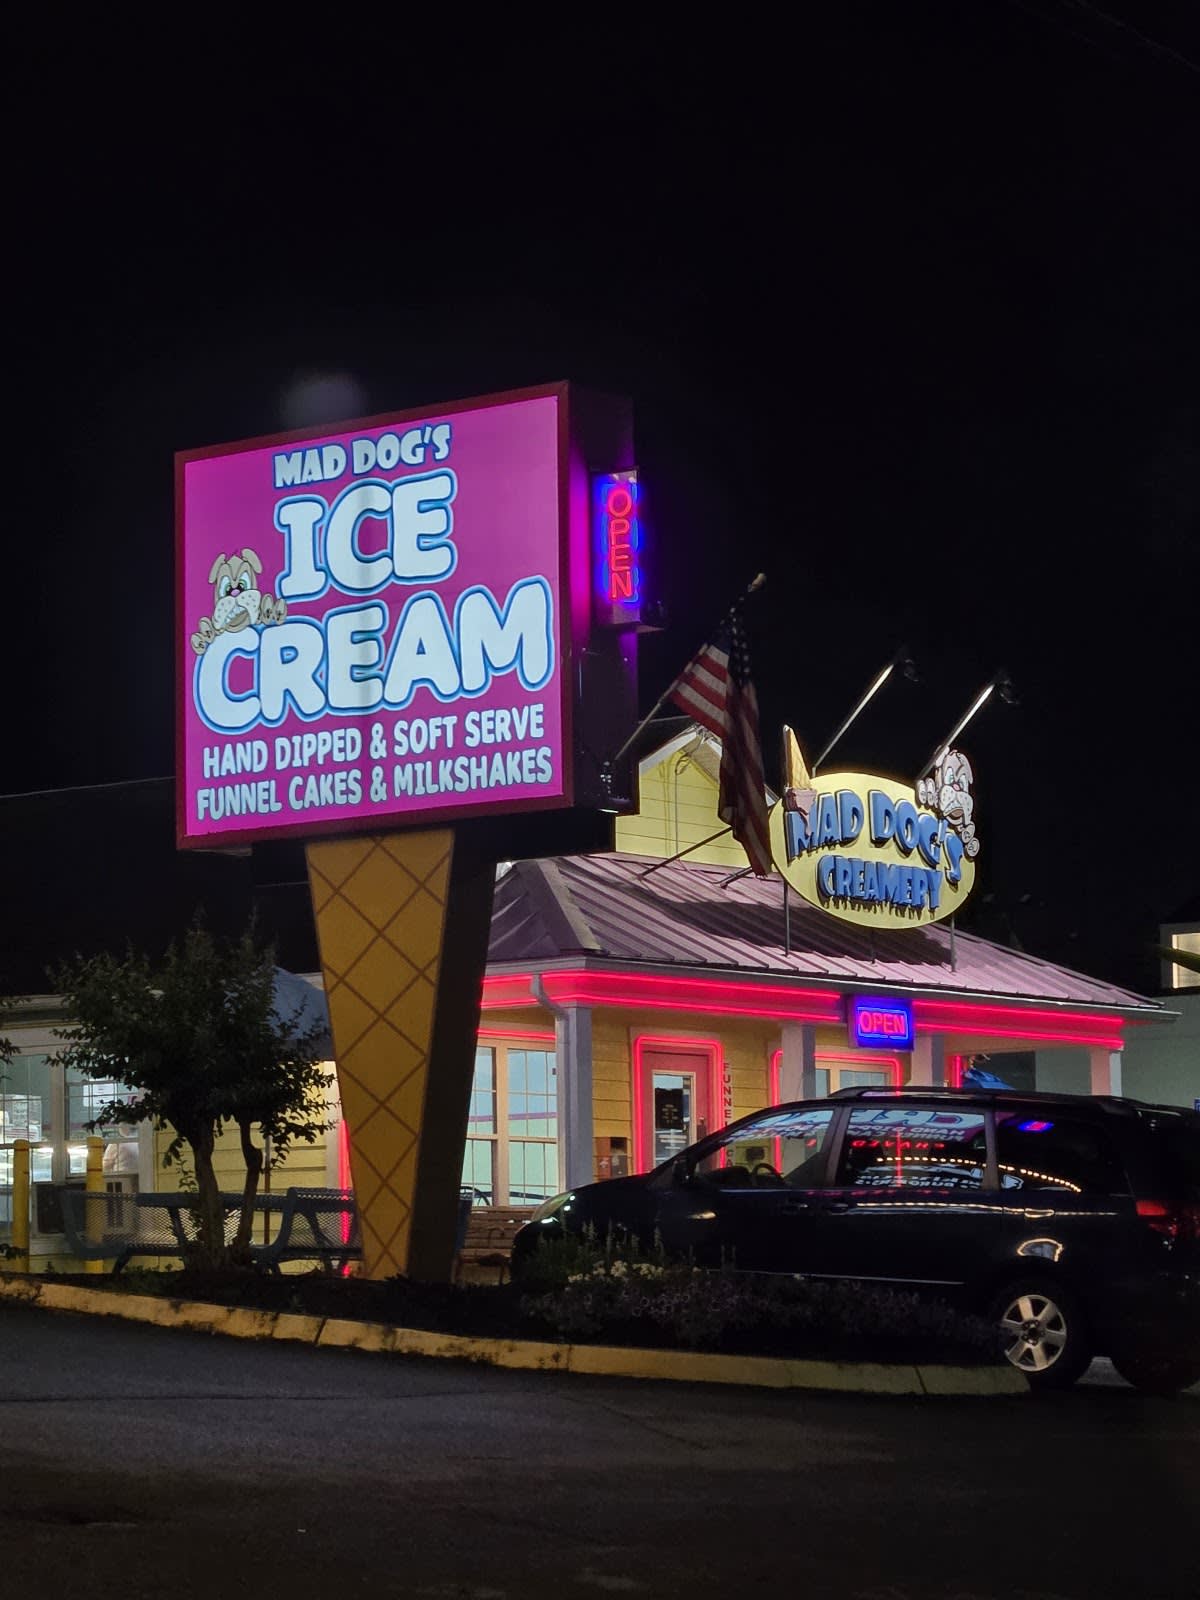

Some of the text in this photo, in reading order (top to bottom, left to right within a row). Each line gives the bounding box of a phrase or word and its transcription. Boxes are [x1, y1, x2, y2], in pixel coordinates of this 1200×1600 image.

[274, 424, 452, 488] MAD DOG'S
[274, 468, 457, 601] ICE
[608, 489, 632, 598] OPEN
[193, 575, 553, 734] CREAM
[203, 703, 545, 778] HAND DIPPED & SOFT SERVE
[197, 747, 553, 821] FUNNEL CAKES & MILKSHAKES
[786, 789, 965, 884] MAD DOG'S
[817, 855, 943, 911] CREAMERY
[860, 1011, 906, 1035] OPEN
